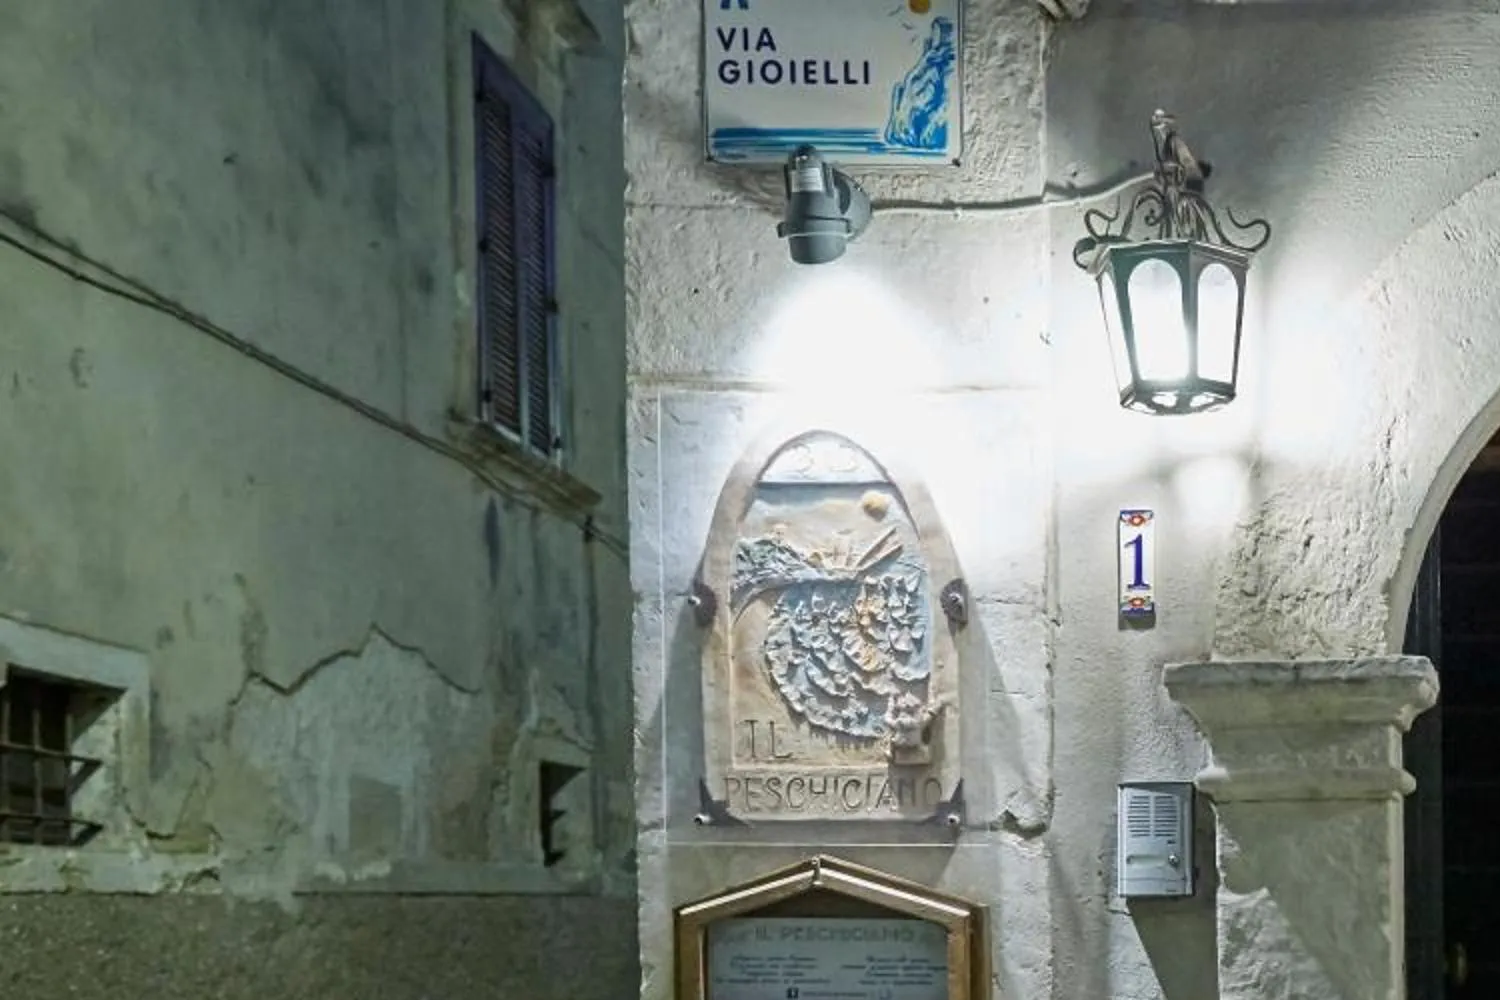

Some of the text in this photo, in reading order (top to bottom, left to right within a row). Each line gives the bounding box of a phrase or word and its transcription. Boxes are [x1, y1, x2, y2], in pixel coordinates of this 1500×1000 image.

[717, 27, 778, 52] VIA
[718, 60, 871, 85] GIOIELLI
[1124, 533, 1150, 592] 1
[742, 718, 794, 760] IL
[723, 775, 943, 812] PESCHICIANO
